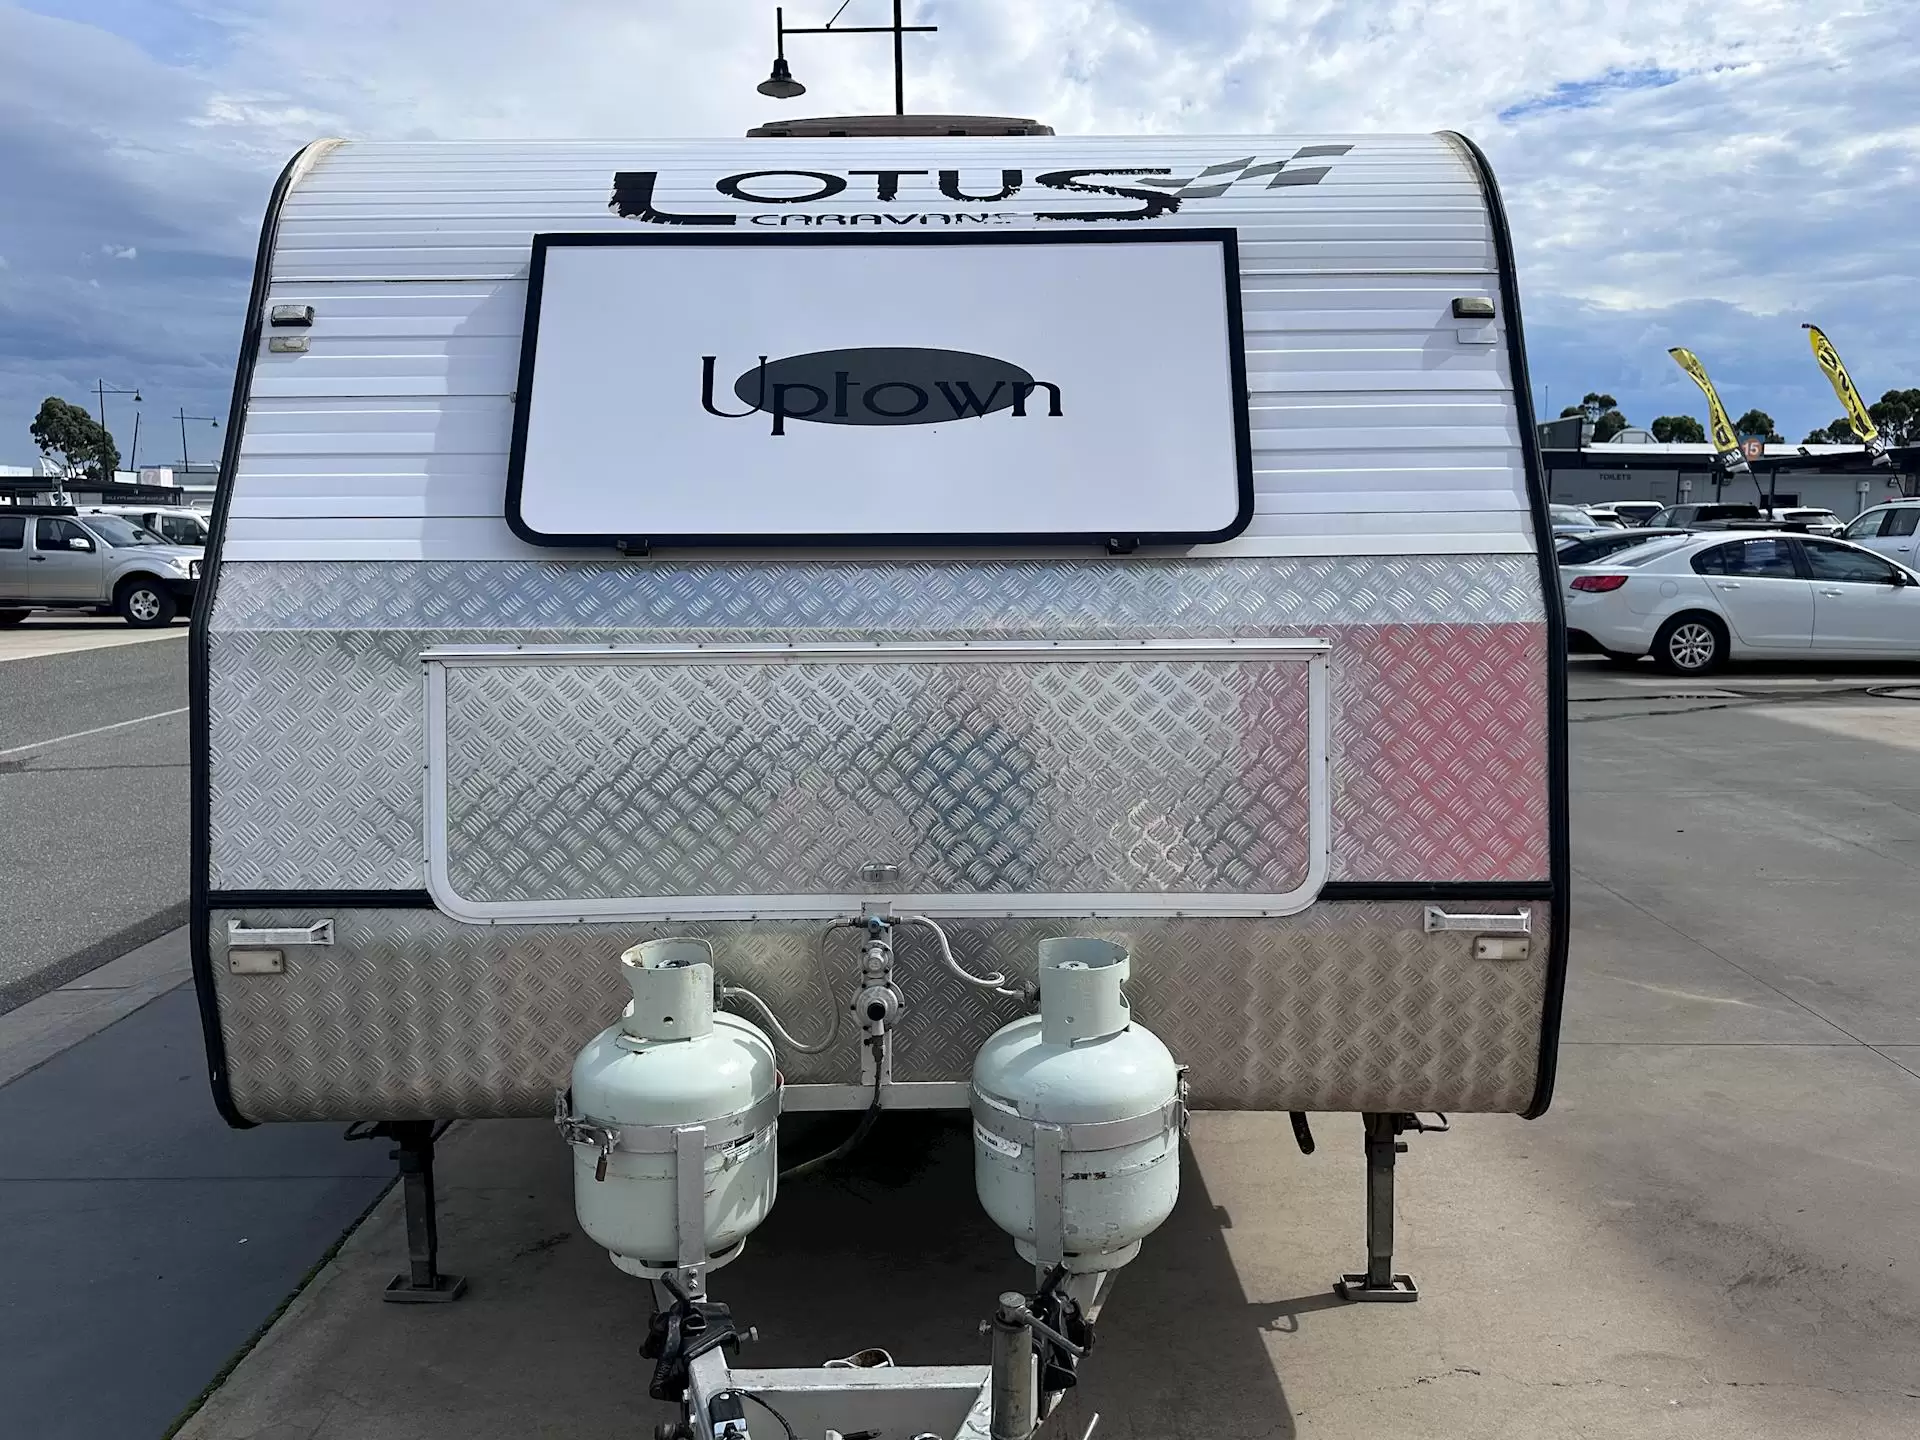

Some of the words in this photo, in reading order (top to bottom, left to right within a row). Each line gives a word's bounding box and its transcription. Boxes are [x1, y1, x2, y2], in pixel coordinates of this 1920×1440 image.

[609, 168, 1182, 225] LOTUS
[701, 355, 1063, 436] Uptown
[1742, 441, 1759, 457] 15
